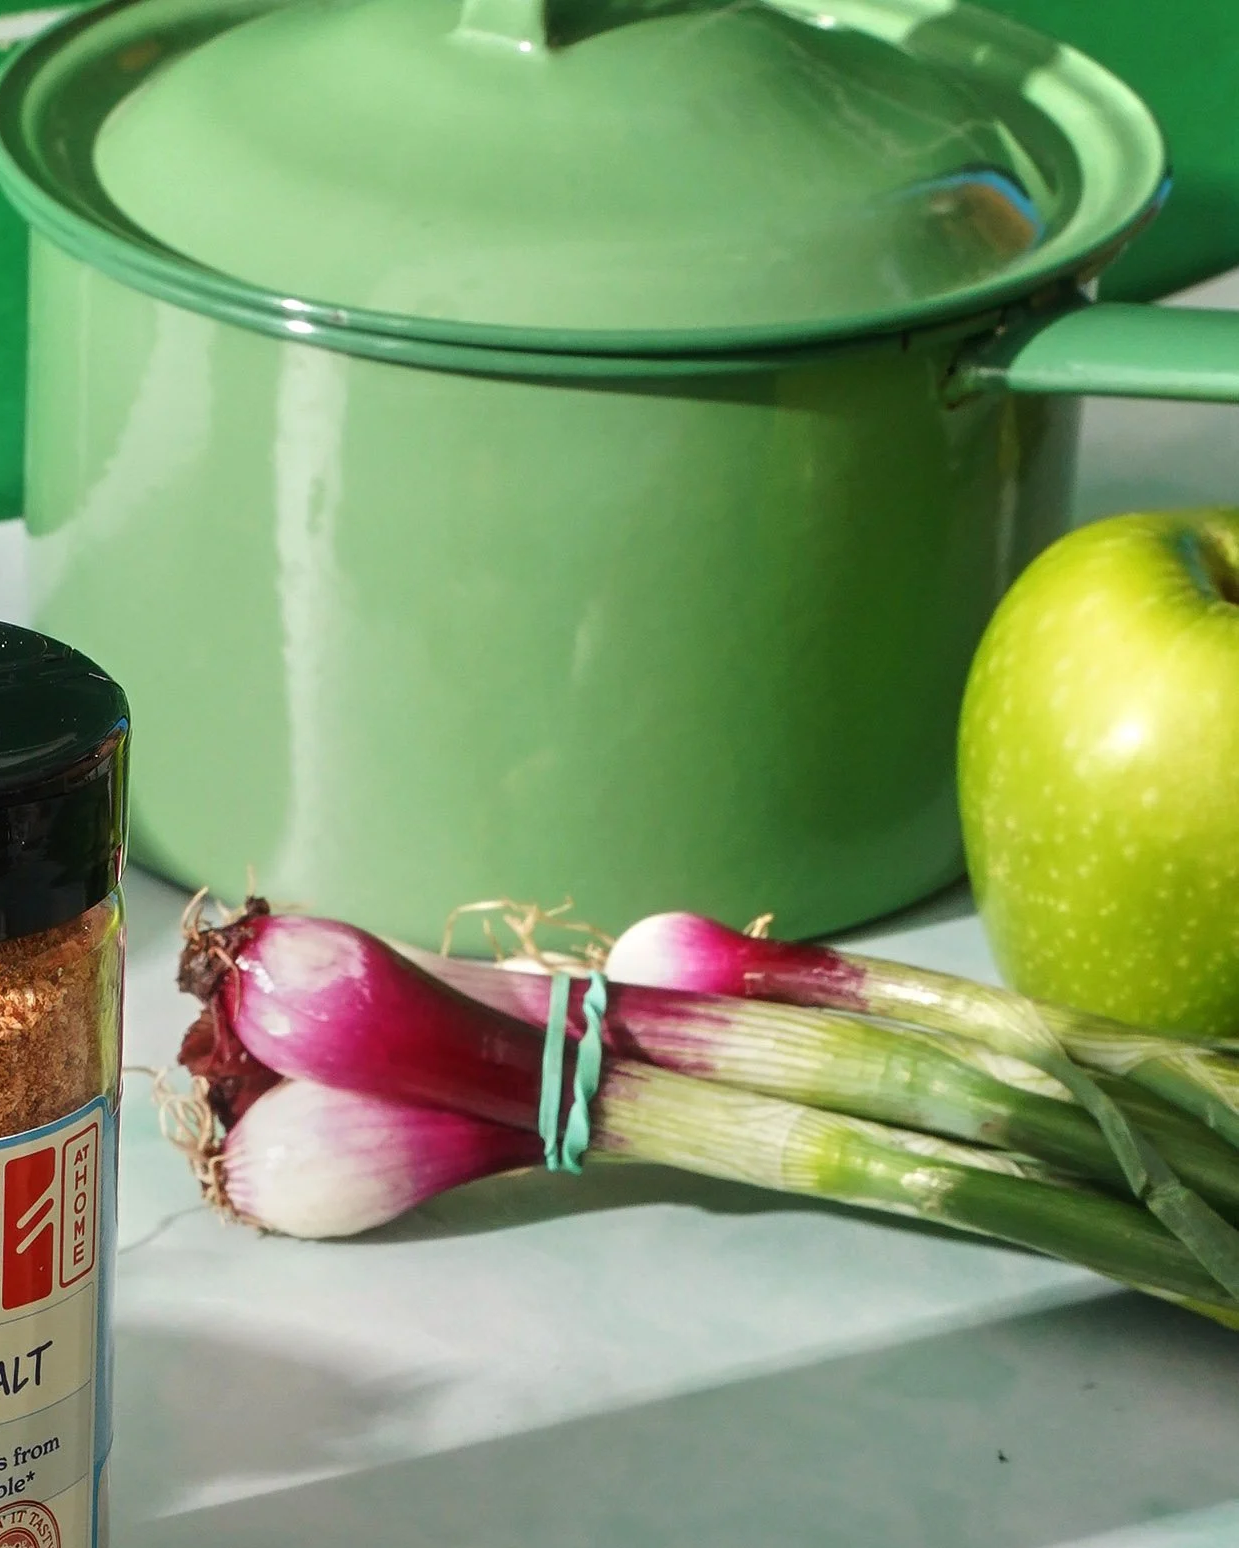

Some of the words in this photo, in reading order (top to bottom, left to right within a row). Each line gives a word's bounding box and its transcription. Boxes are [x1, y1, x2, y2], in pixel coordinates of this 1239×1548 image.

[74, 1146, 89, 1166] AT
[73, 1171, 88, 1267] HOME
[13, 1435, 60, 1465] from
[12, 1510, 27, 1524] IT
